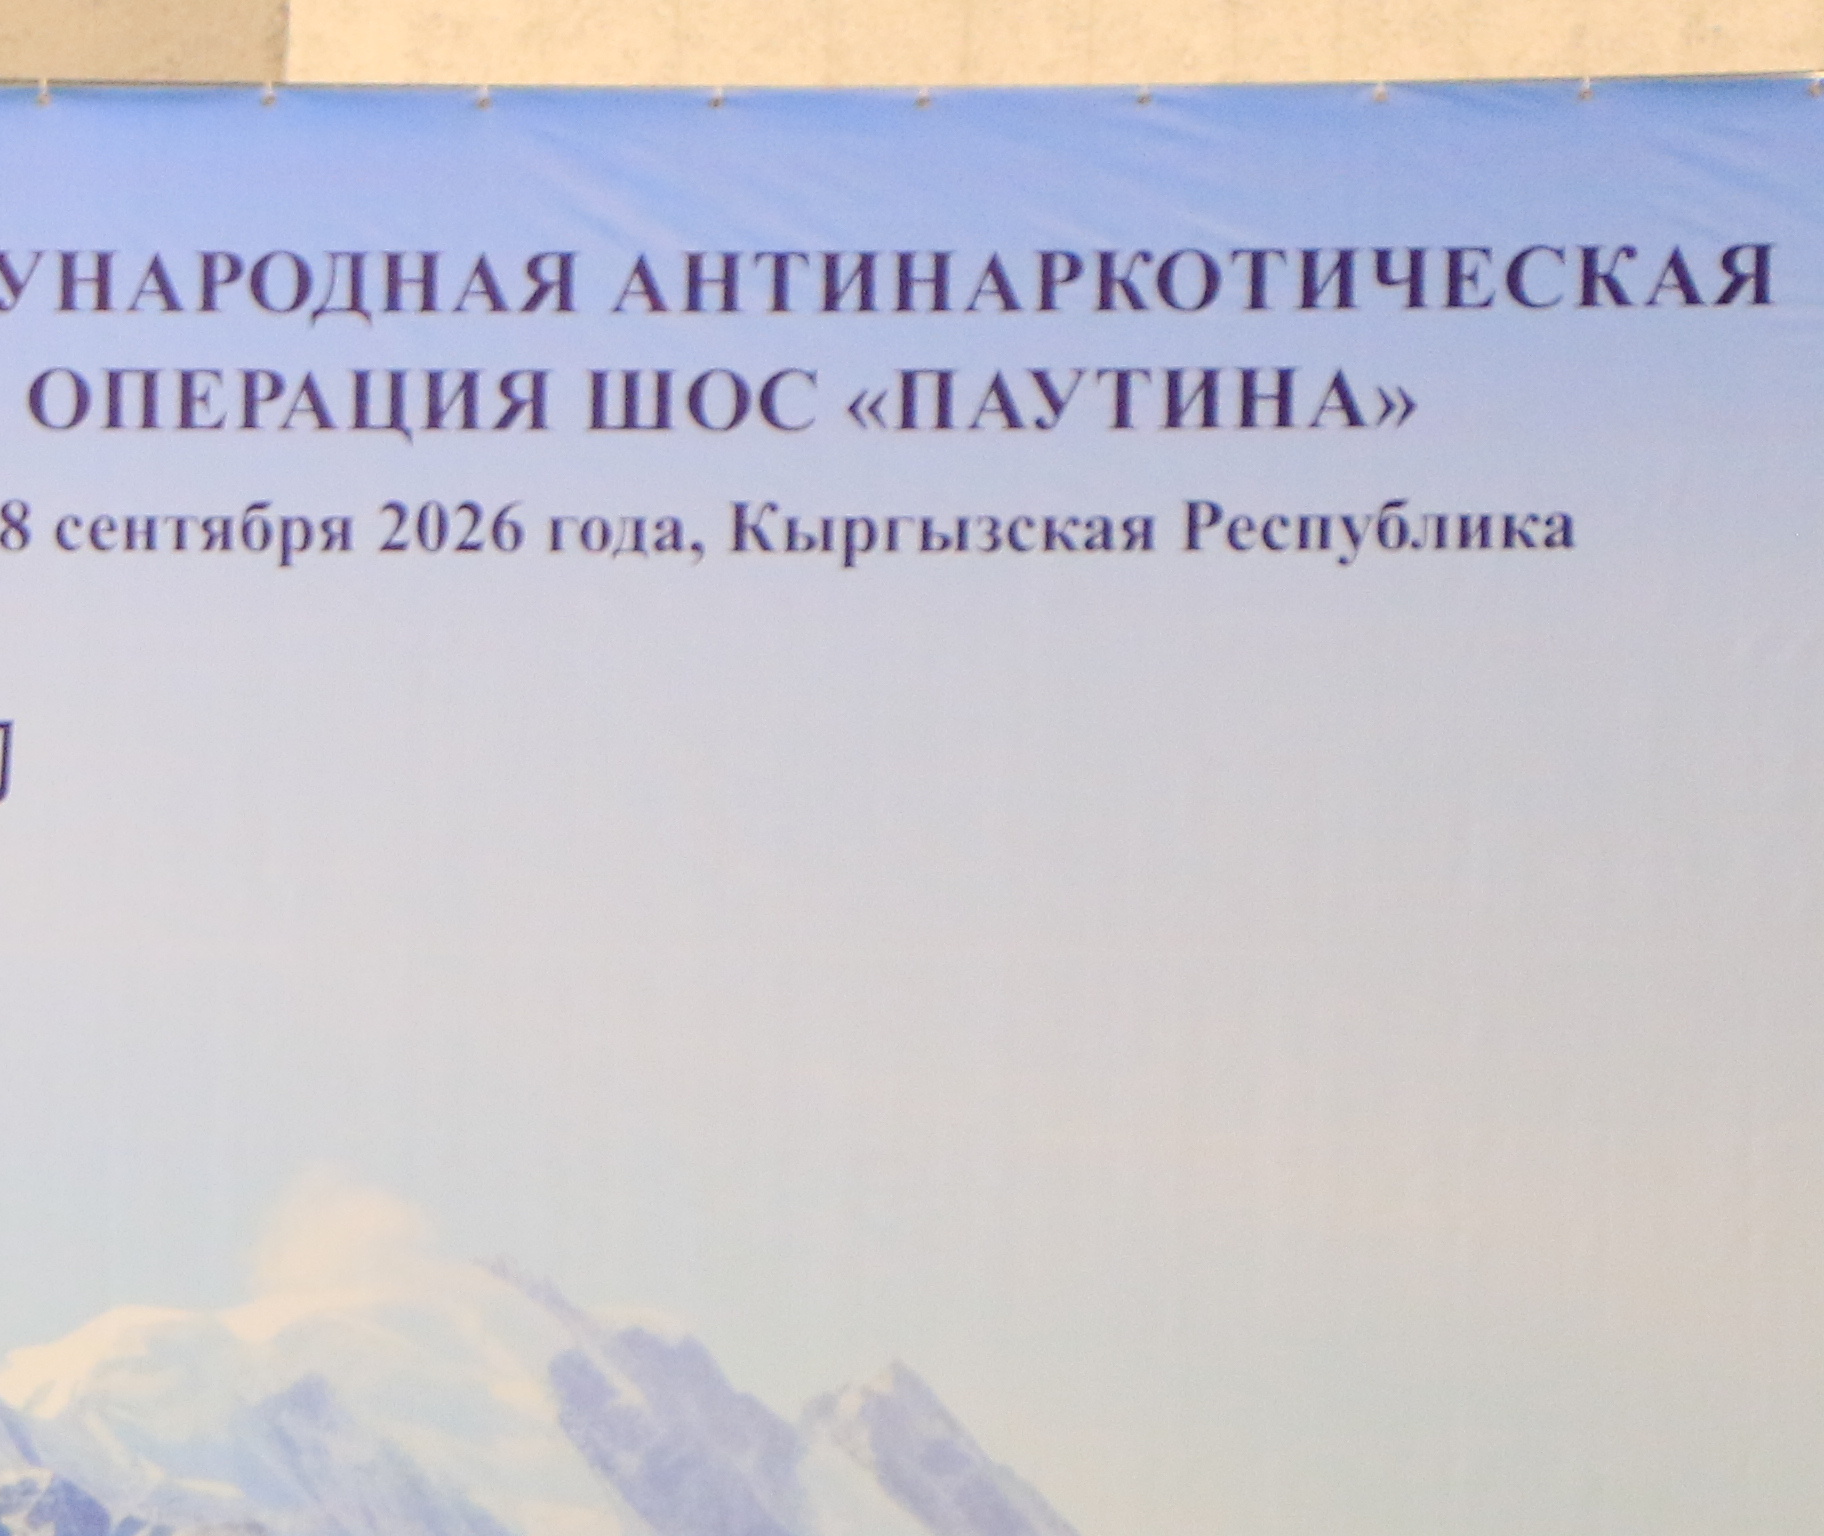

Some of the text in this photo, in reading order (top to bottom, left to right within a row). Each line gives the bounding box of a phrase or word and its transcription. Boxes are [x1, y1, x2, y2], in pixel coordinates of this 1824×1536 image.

[611, 243, 1777, 314] АНТИНАРКОТИЧЕСКАЯ
[27, 367, 1417, 442] ОПЕРАЦИЯ ШОС «ПАУТИНА»
[54, 499, 353, 568] сентября
[379, 500, 526, 553] 2026
[549, 515, 706, 562] года,
[729, 500, 1155, 569] Кыргызская
[1183, 497, 1577, 568] Республика
